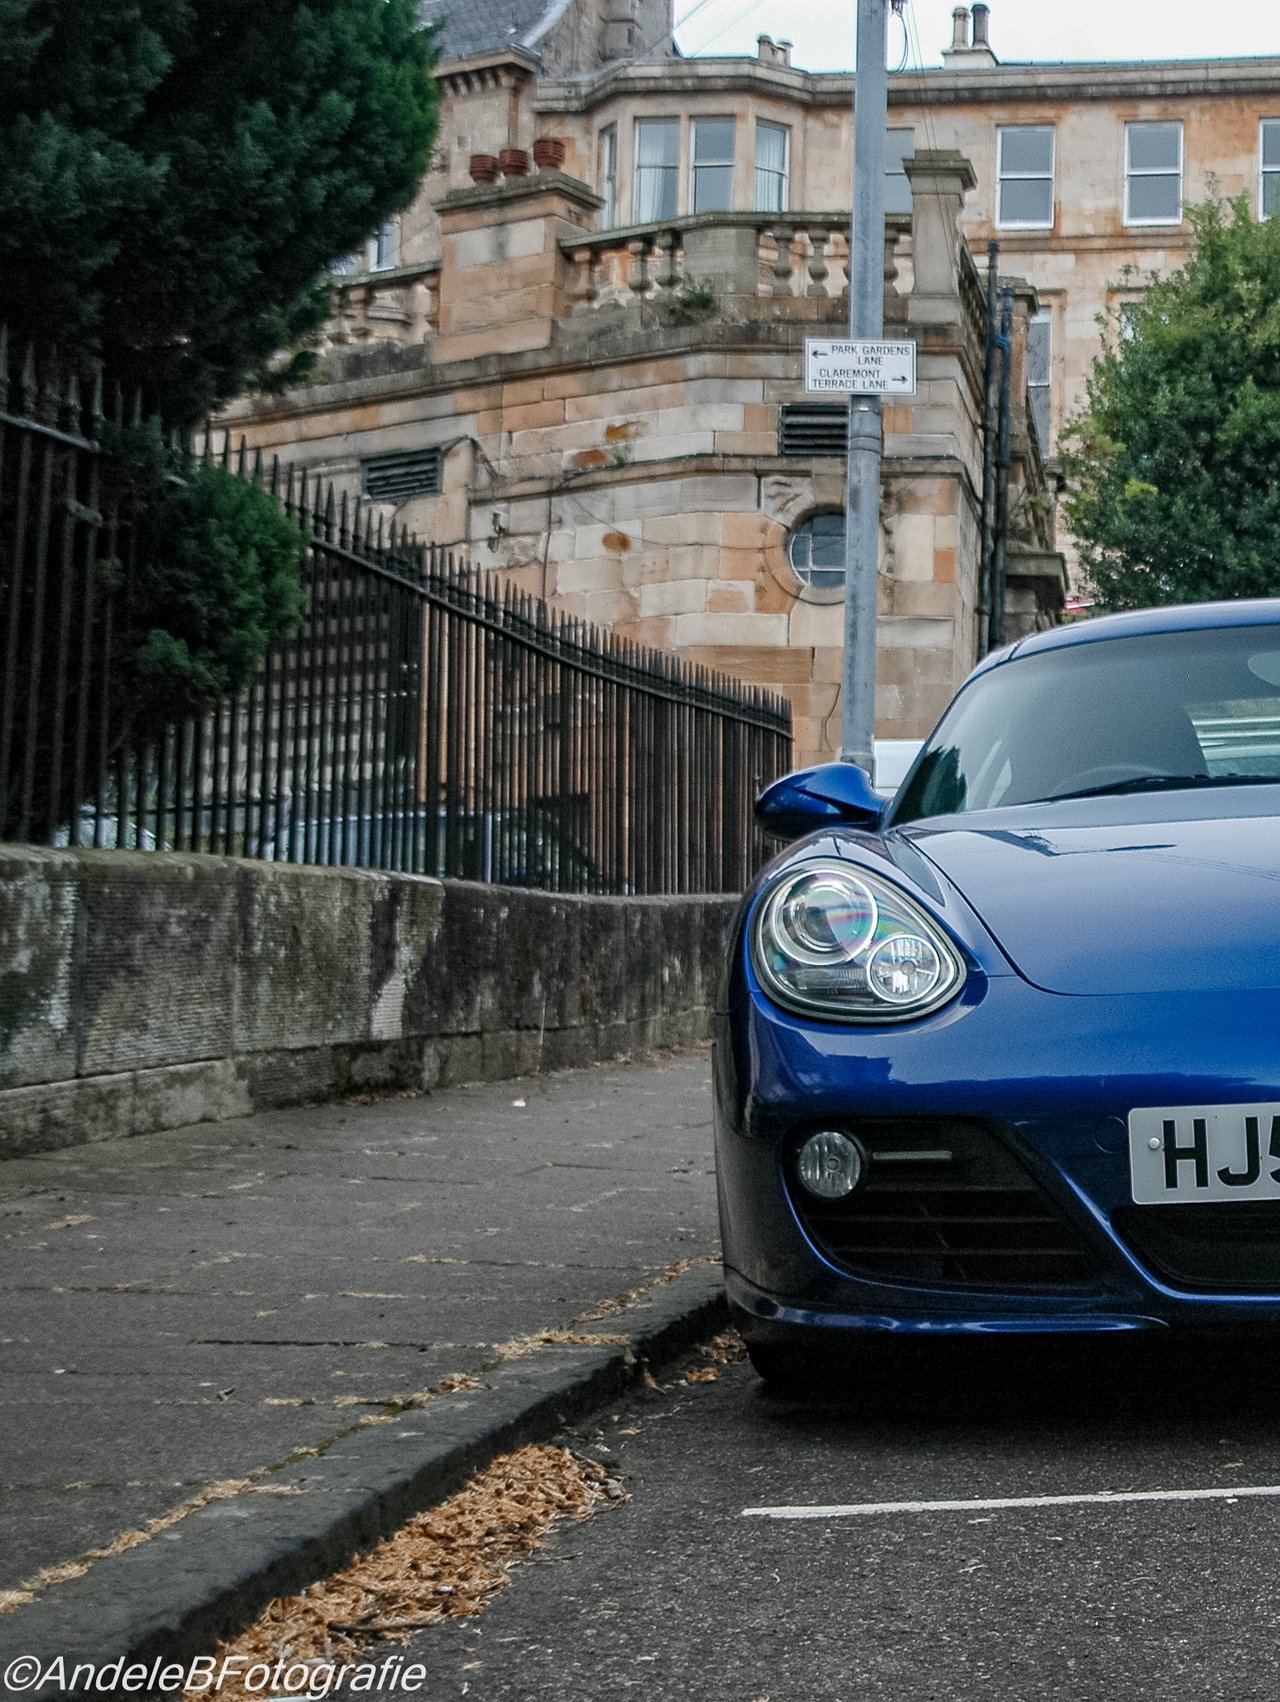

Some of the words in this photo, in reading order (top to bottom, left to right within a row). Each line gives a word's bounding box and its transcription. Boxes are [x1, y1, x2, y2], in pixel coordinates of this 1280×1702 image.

[831, 345, 857, 354] PARK
[862, 345, 911, 356] GARDENS
[858, 357, 884, 366] LANE
[819, 369, 881, 379] CLAREMONT
[812, 379, 859, 389] TERRACE
[863, 380, 889, 390] LANE
